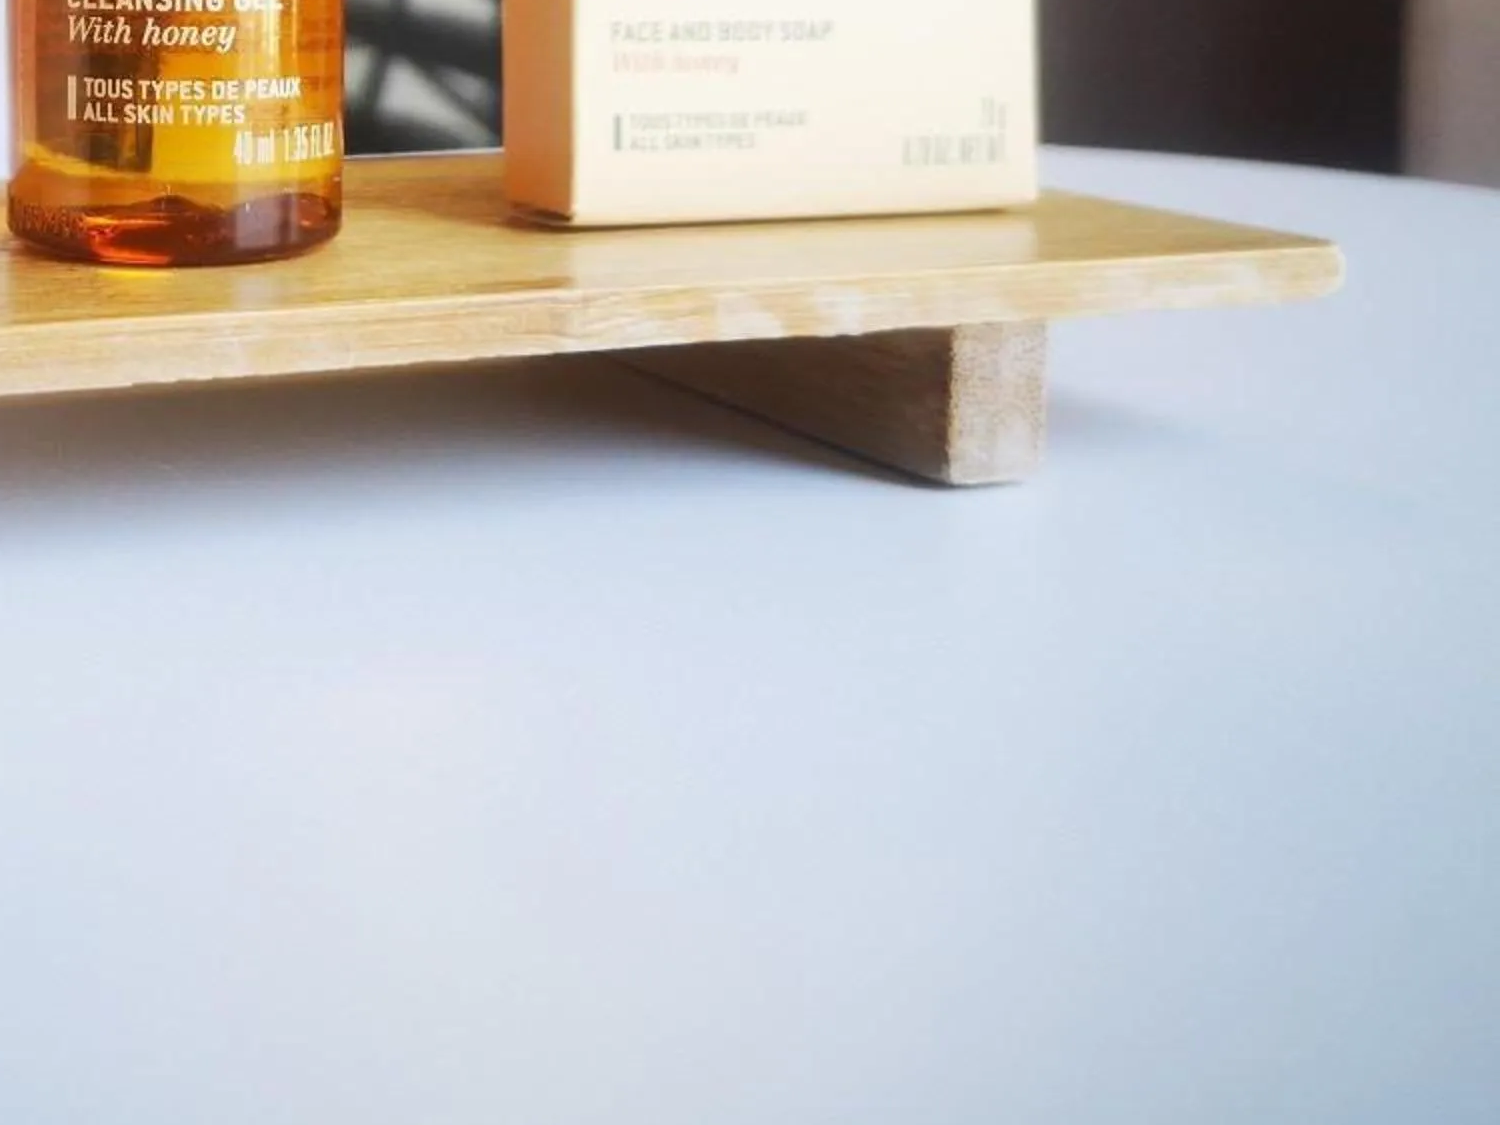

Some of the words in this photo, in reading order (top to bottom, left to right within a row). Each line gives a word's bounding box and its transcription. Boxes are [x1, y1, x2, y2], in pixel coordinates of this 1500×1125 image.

[67, 15, 132, 45] With
[141, 17, 237, 54] honey
[610, 21, 664, 42] FACE
[669, 21, 711, 42] AND
[718, 21, 774, 42] BODY
[780, 21, 835, 42] SOAP
[83, 77, 134, 100] TOUS
[139, 79, 205, 101] TYPES
[211, 78, 240, 100] DE
[245, 77, 301, 99] PEAUX
[83, 104, 120, 124] ALL
[124, 104, 175, 124] SKIN
[181, 104, 245, 124] TYPES
